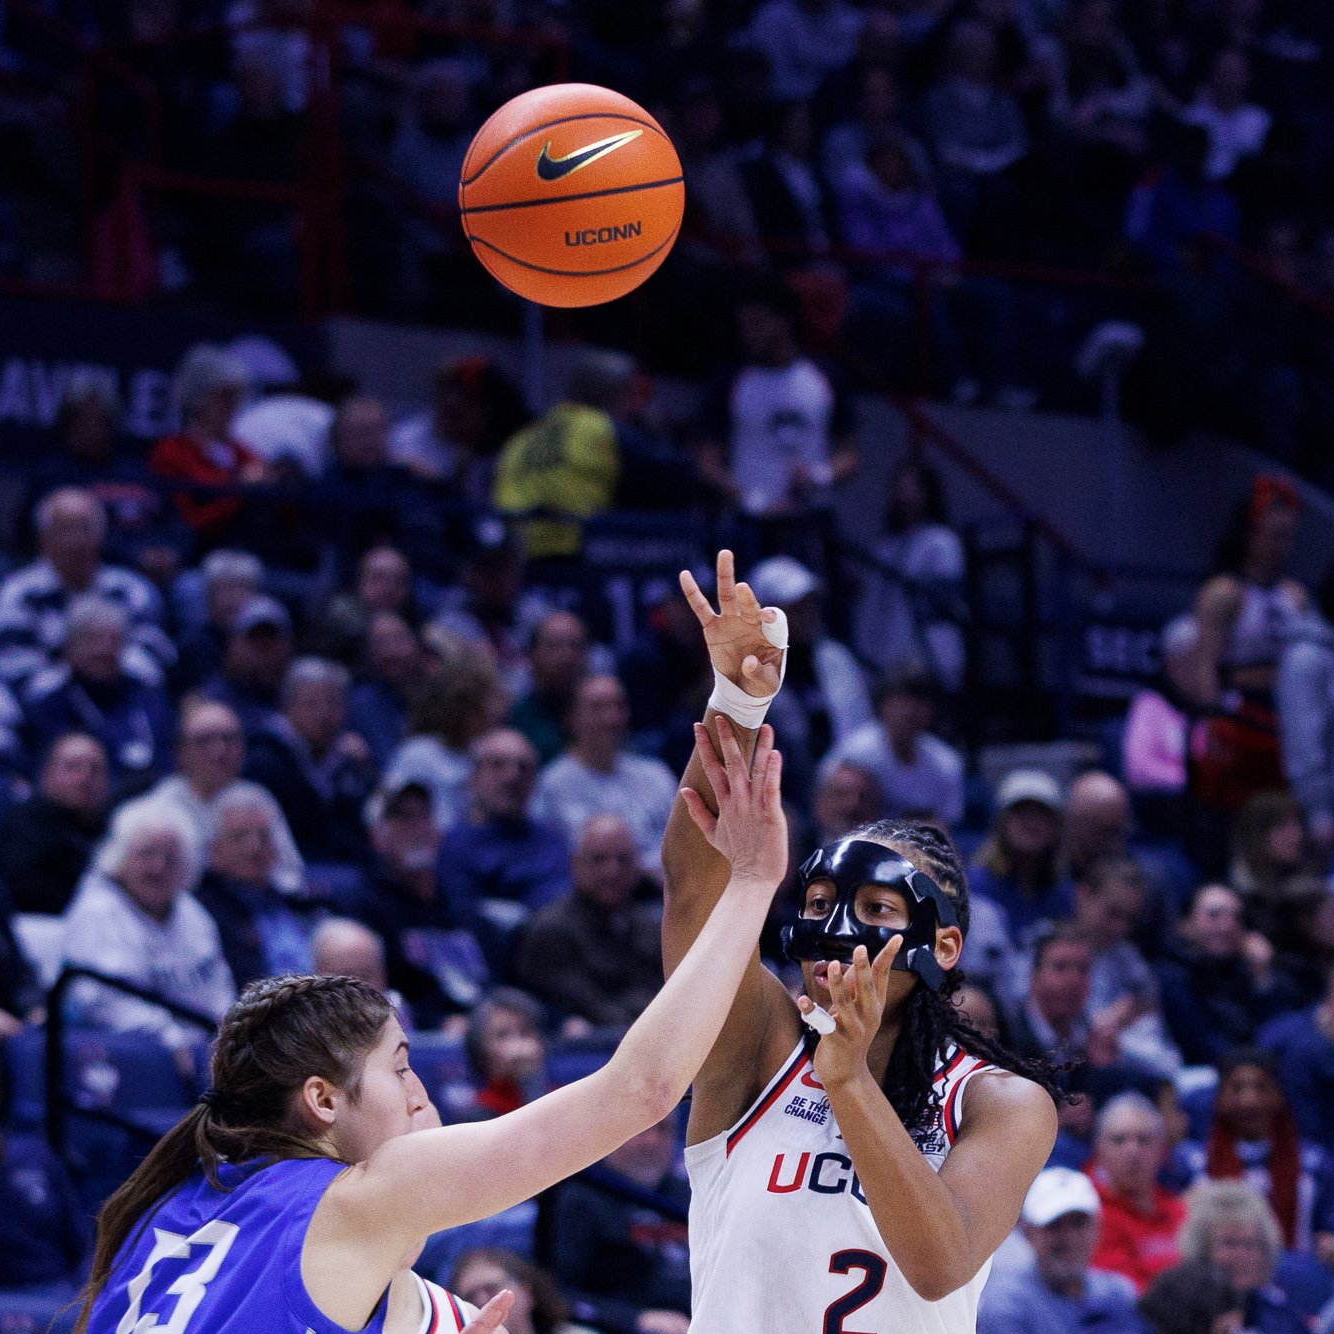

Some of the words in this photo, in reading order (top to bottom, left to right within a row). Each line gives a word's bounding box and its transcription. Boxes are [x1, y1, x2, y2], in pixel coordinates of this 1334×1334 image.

[564, 220, 642, 247] UCONN
[784, 1104, 828, 1126] CHANGE
[791, 1095, 808, 1108] BE
[808, 1100, 829, 1115] THE
